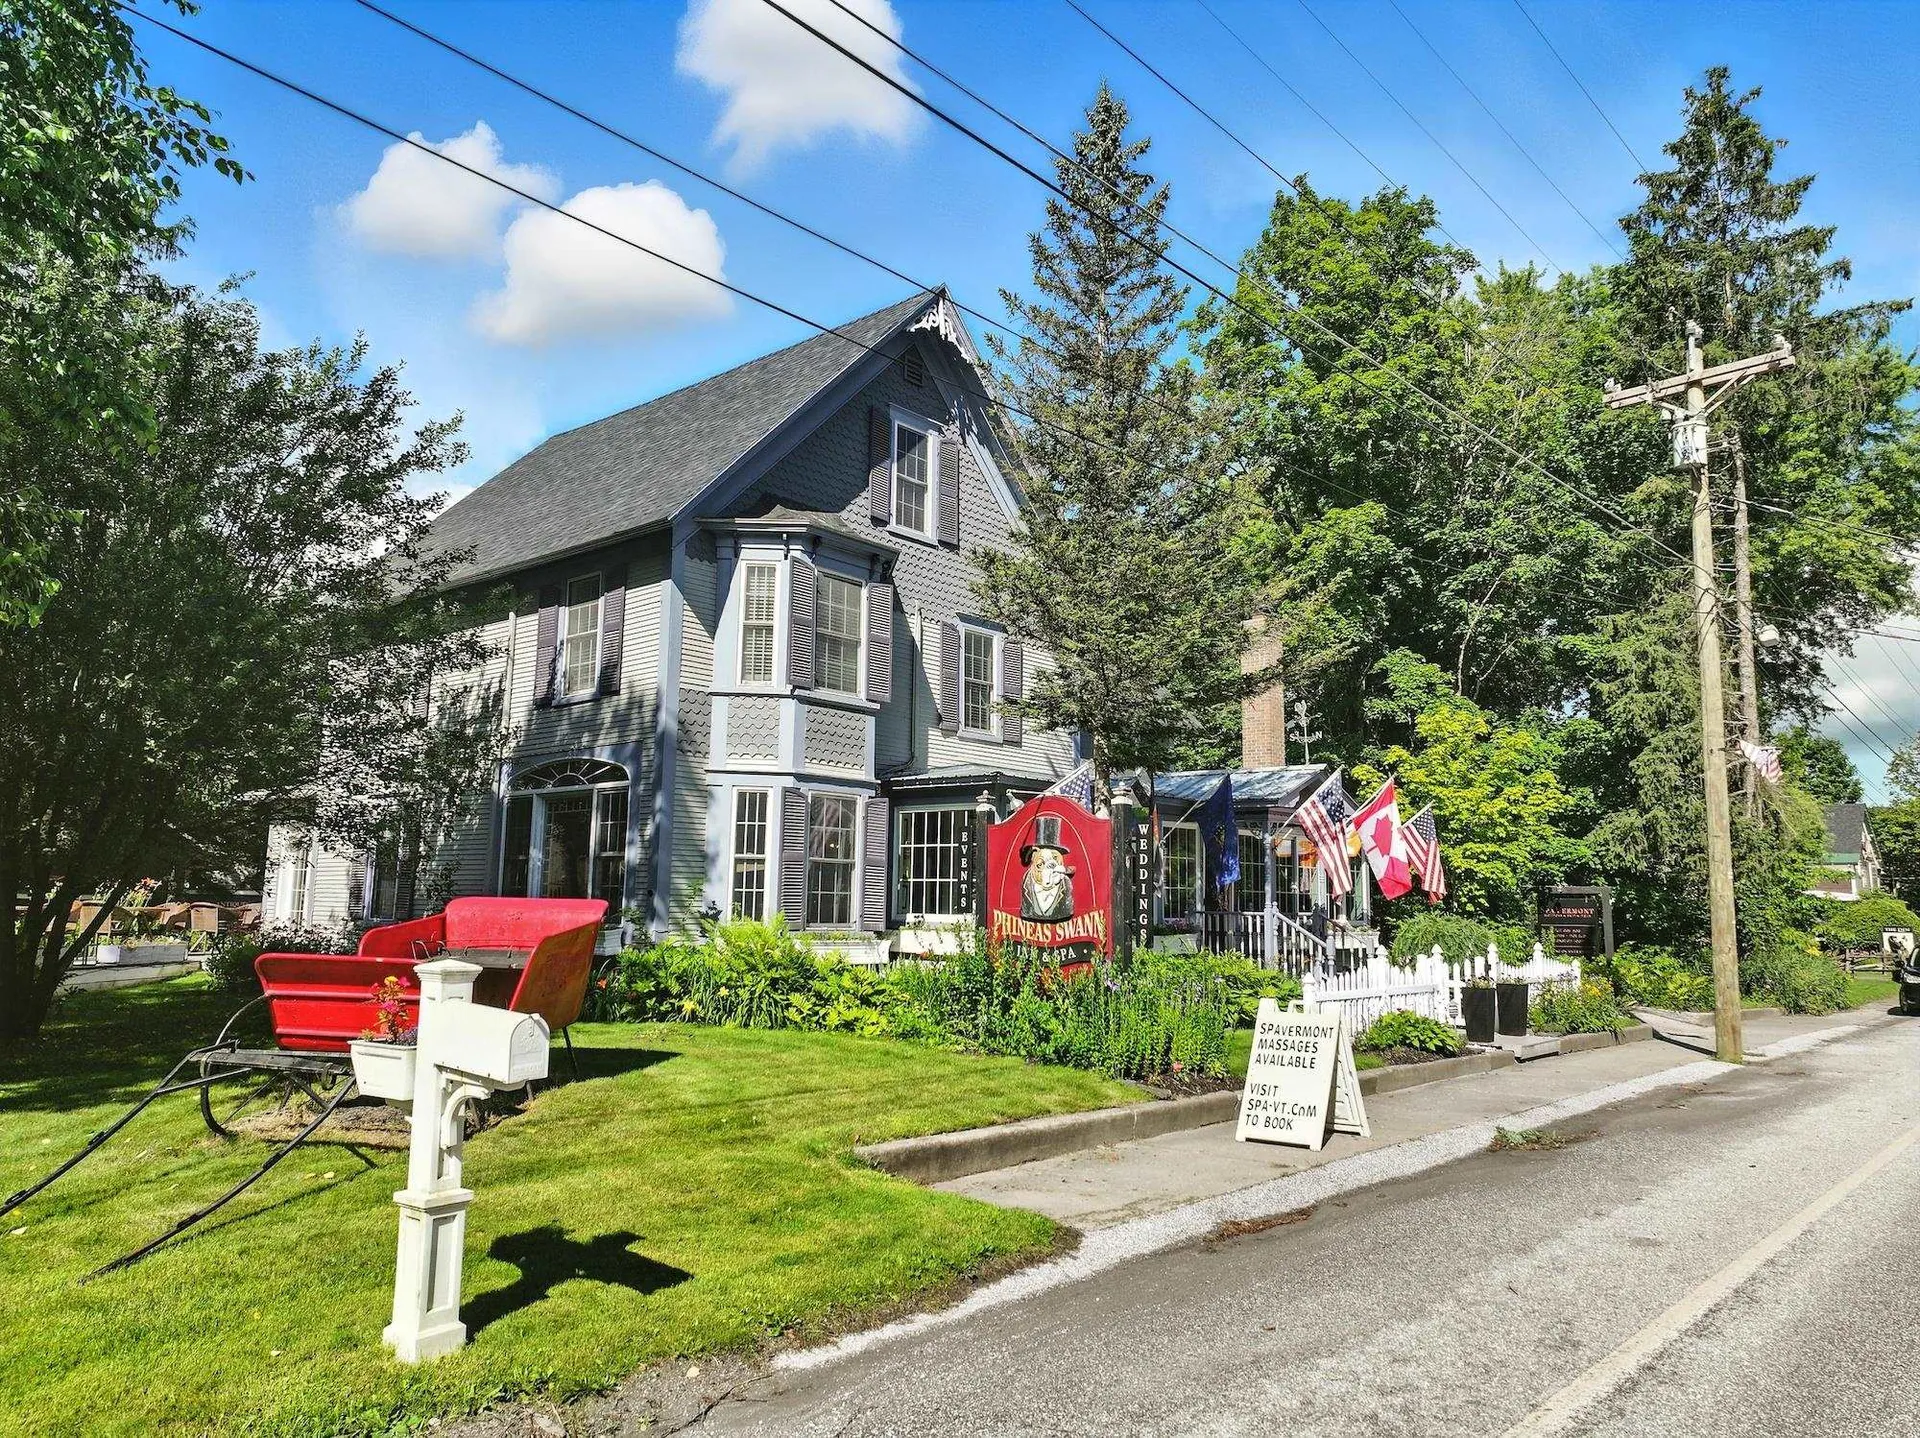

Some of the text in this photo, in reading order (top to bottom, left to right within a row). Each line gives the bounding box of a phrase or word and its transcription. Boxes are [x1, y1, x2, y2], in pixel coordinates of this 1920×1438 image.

[960, 832, 968, 908] EVENTS
[1138, 824, 1149, 941] WEDDINGS
[993, 908, 1104, 943] PHINEAS SWANN
[1260, 1023, 1335, 1039] SPAVERMONT
[1257, 1038, 1319, 1054] MASSAGES
[1255, 1053, 1316, 1069] AVAILABLE
[1250, 1083, 1279, 1097] VISIT
[1245, 1114, 1294, 1131] TO BOOK
